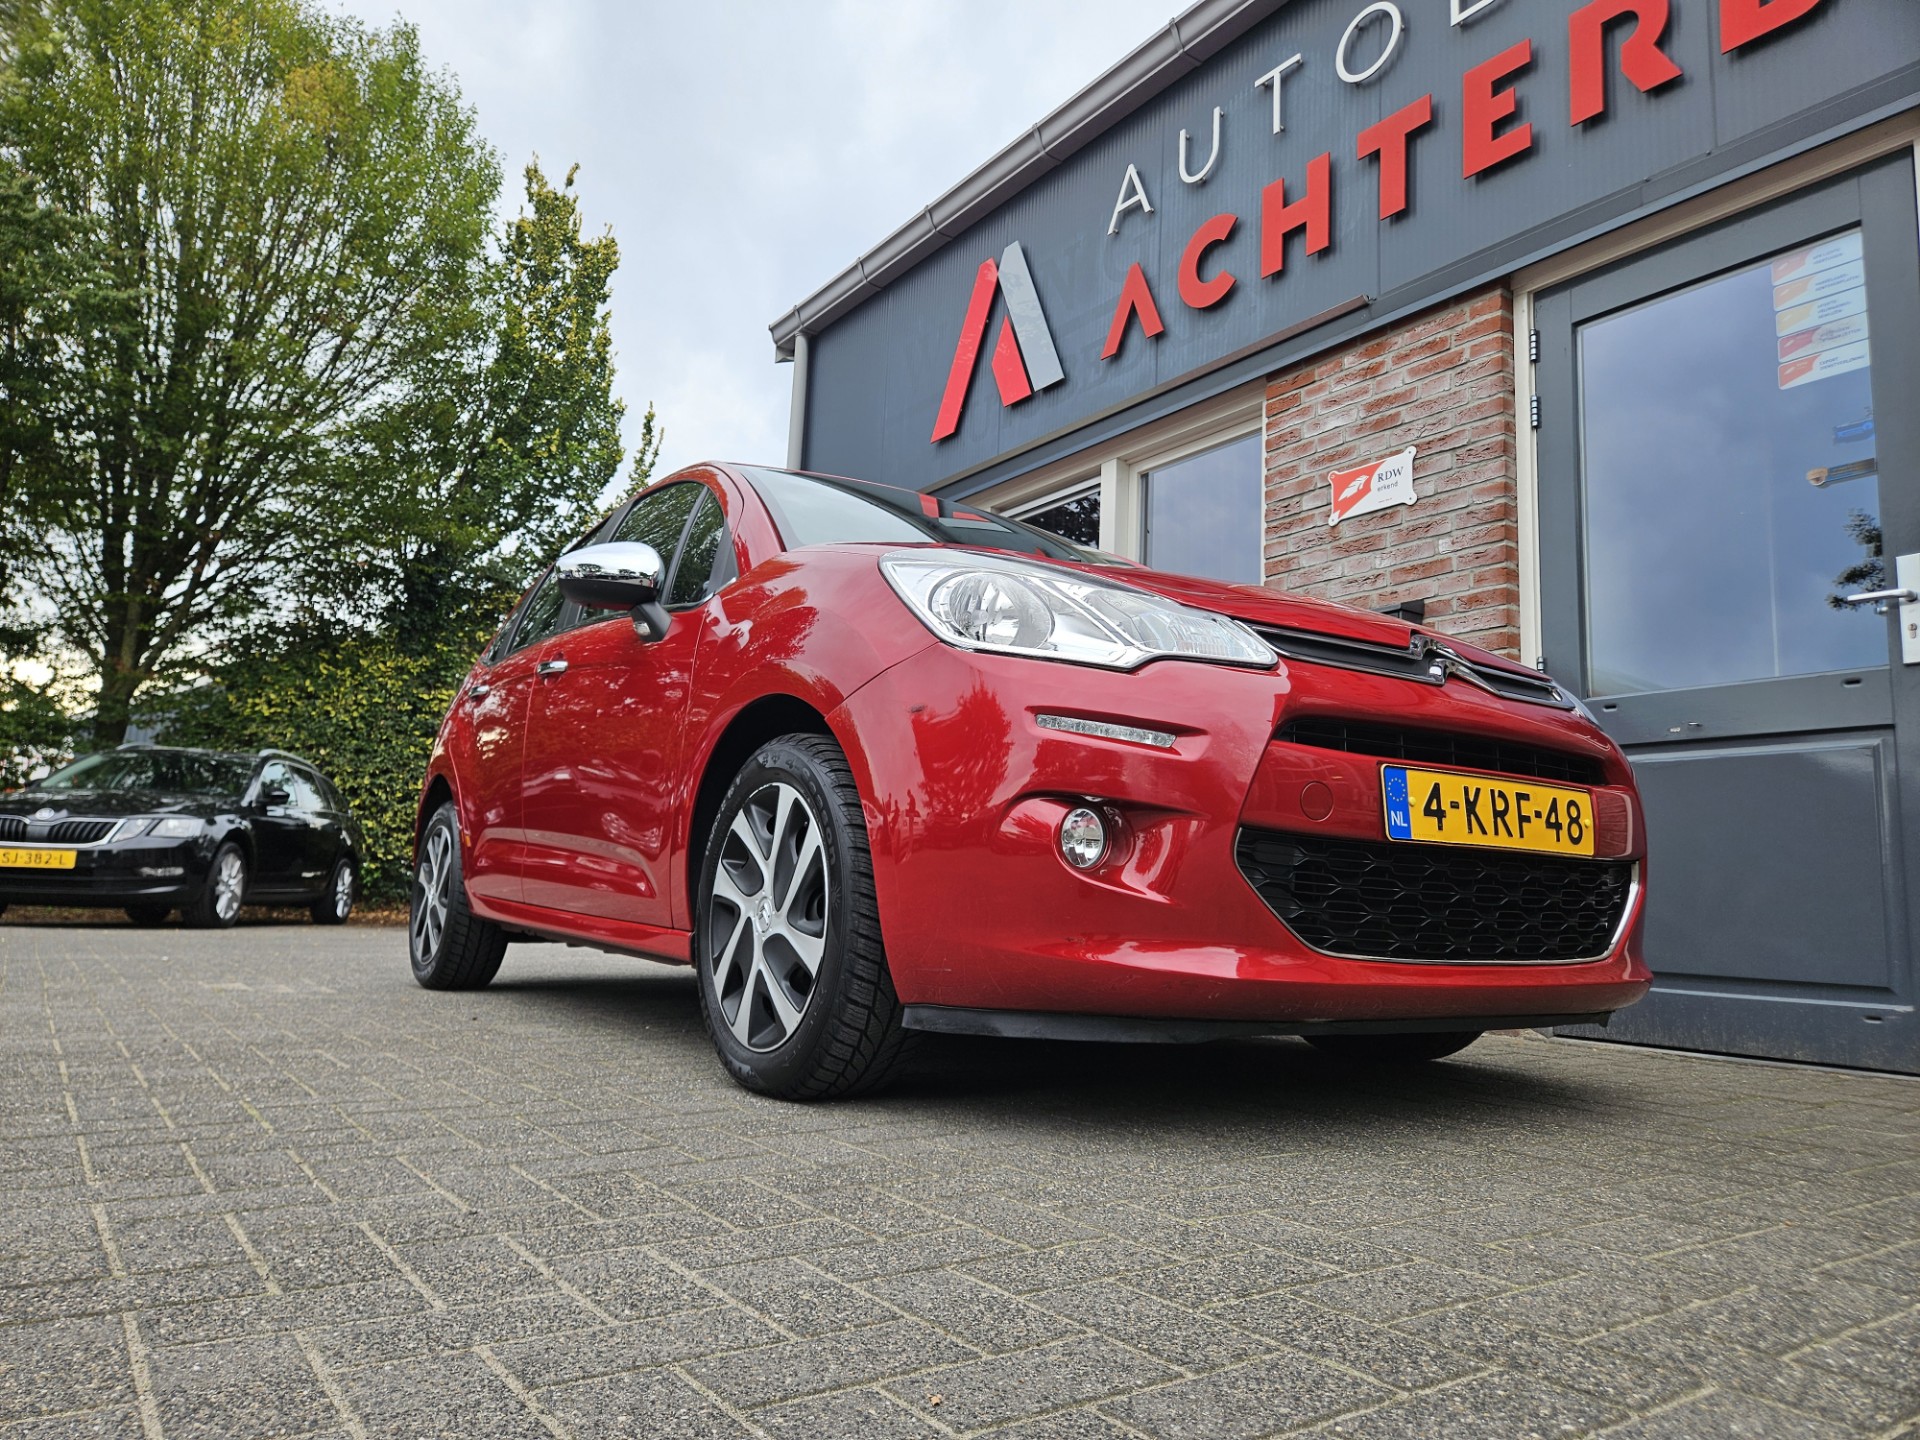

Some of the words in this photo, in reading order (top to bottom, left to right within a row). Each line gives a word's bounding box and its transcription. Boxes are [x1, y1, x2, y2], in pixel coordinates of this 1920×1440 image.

[1377, 467, 1404, 482] RDW
[1377, 481, 1399, 492] erkend
[1390, 810, 1408, 828] NL
[1423, 782, 1584, 845] 4-KRF-48
